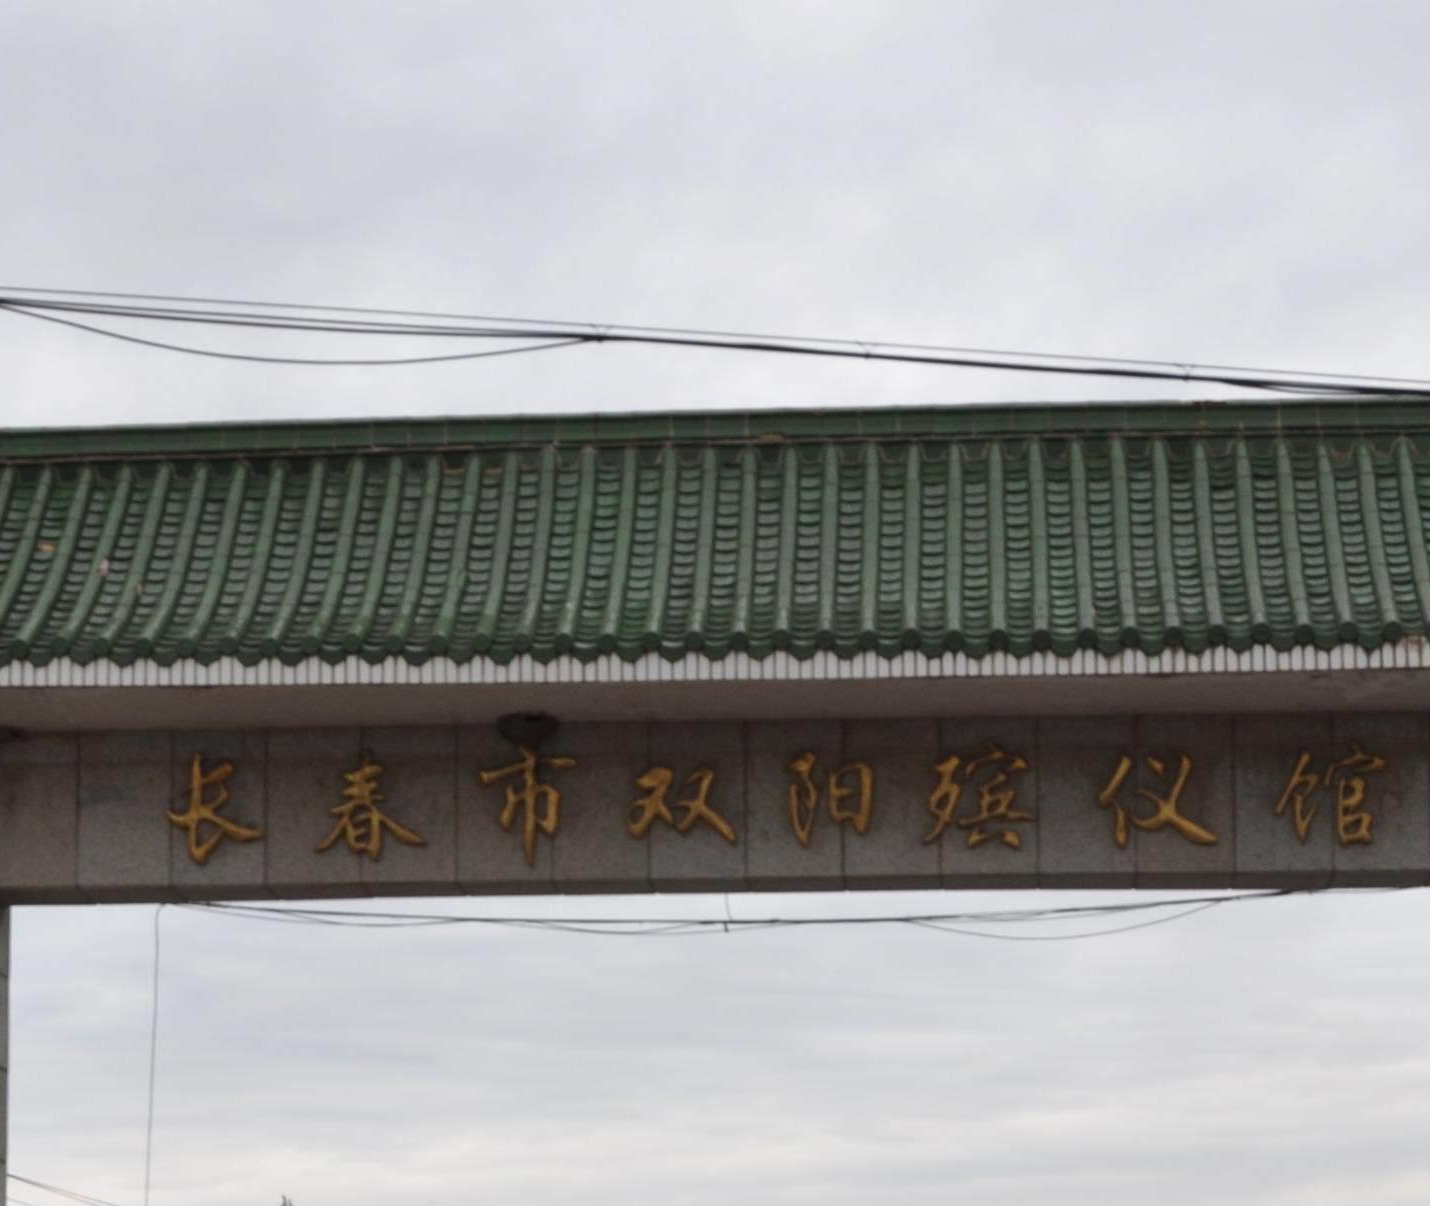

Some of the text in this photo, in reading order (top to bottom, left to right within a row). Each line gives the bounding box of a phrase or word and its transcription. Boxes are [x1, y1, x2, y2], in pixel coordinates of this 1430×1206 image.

[168, 744, 1386, 868] 长春市双阳殡仪馆
